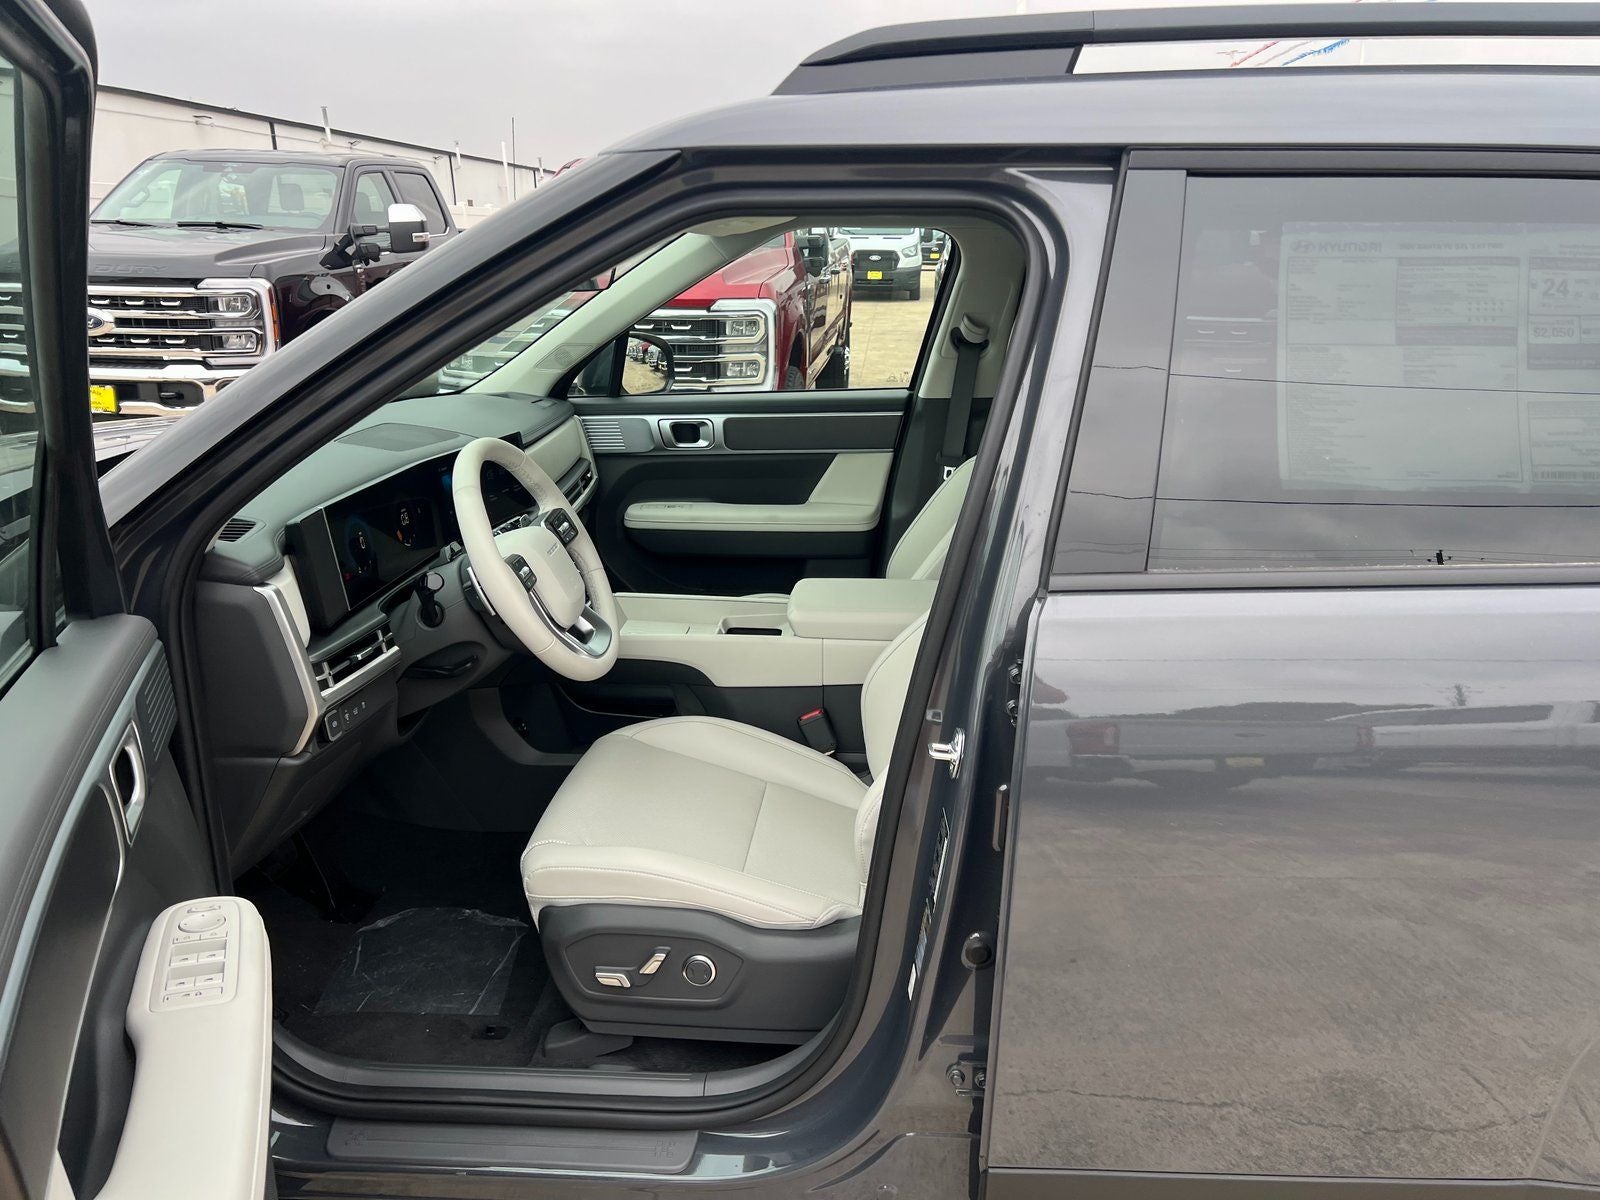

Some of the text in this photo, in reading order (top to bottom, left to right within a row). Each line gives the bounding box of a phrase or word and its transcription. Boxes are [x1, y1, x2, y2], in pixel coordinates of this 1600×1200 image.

[1318, 241, 1382, 253] HYUNDAI
[94, 263, 168, 274] DUTY
[1542, 278, 1570, 297] 24
